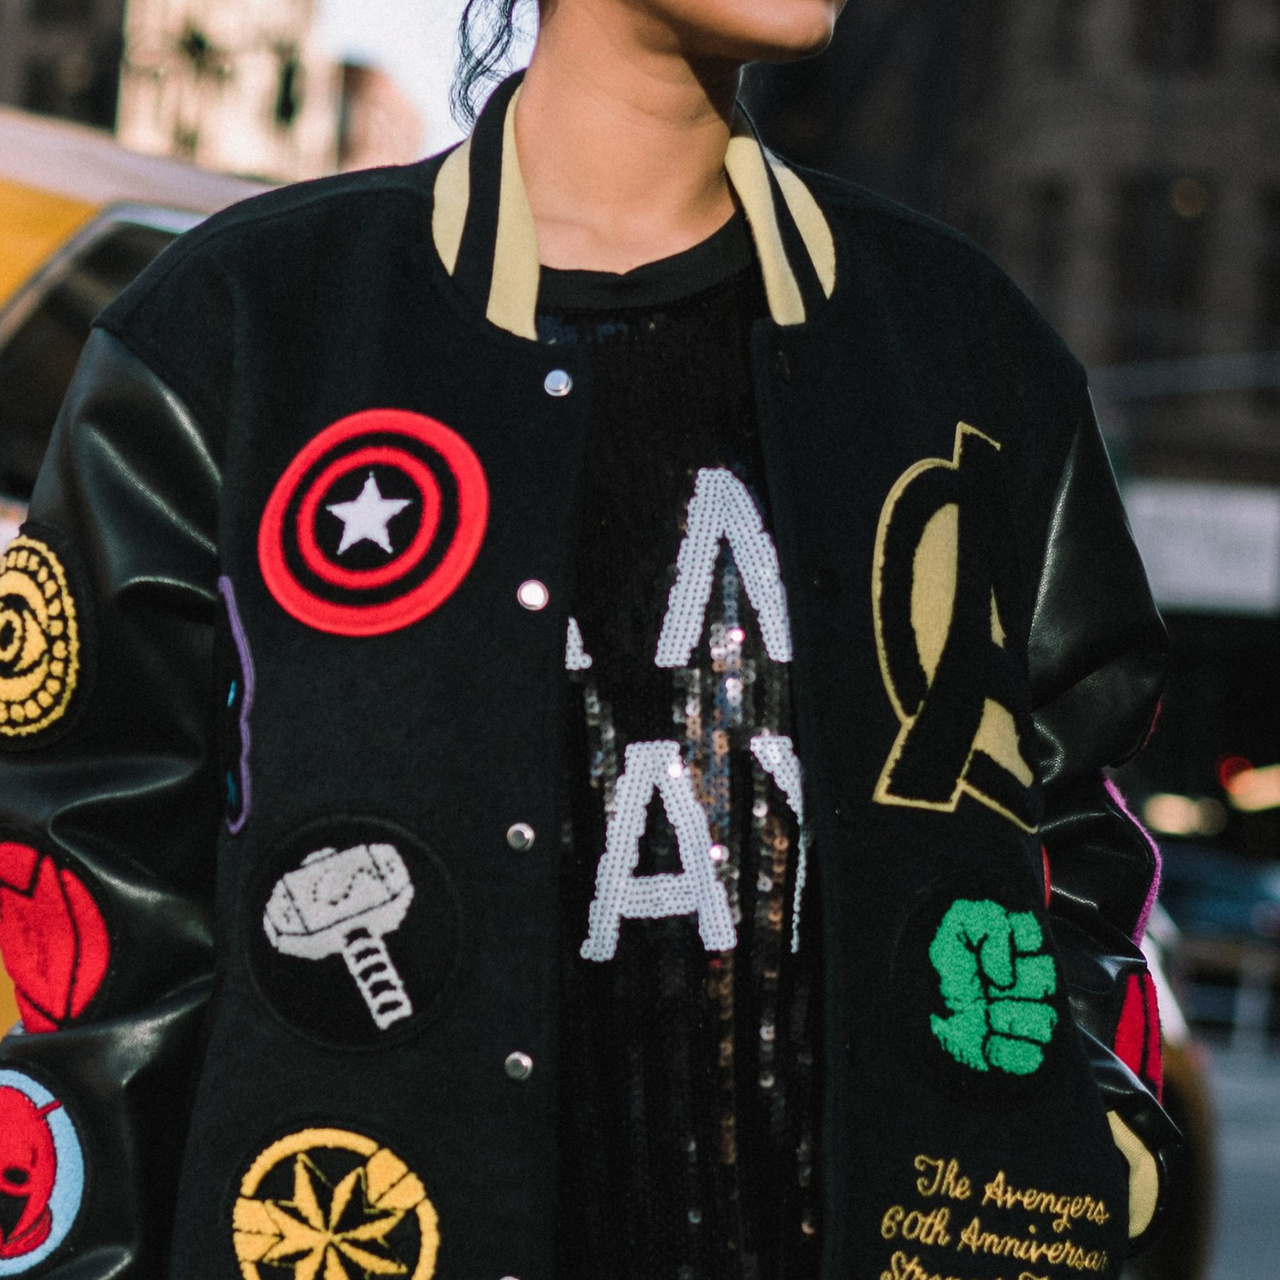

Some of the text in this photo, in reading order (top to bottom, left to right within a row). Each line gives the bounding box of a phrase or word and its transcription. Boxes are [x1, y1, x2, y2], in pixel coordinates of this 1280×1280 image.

[914, 1154, 1109, 1233] The Avengers
[880, 1205, 951, 1246] 60th
